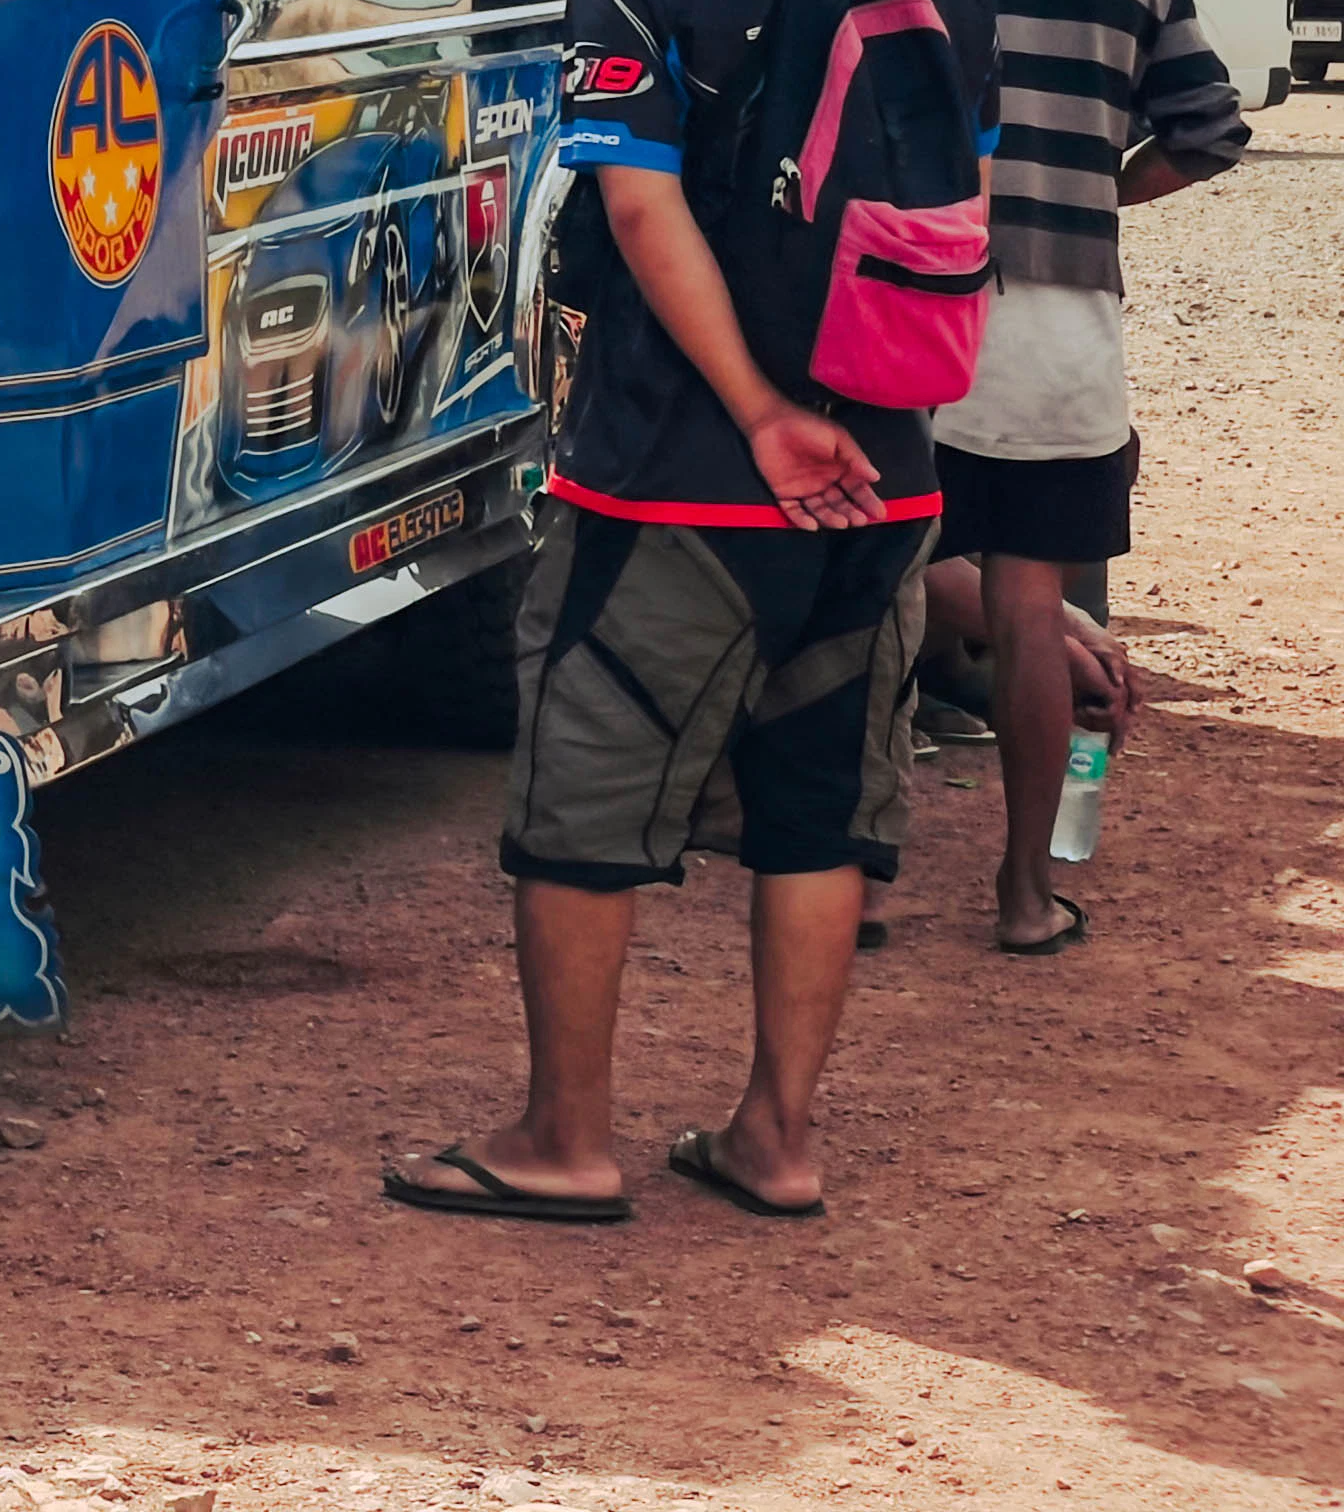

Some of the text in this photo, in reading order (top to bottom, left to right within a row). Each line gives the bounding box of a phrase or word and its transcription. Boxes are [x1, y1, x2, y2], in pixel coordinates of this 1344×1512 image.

[57, 29, 159, 160] AC
[474, 98, 534, 144] SPOON
[216, 122, 312, 204] ICONIC
[69, 191, 153, 272] SPORTS
[260, 305, 294, 329] AC
[353, 524, 388, 571] AC
